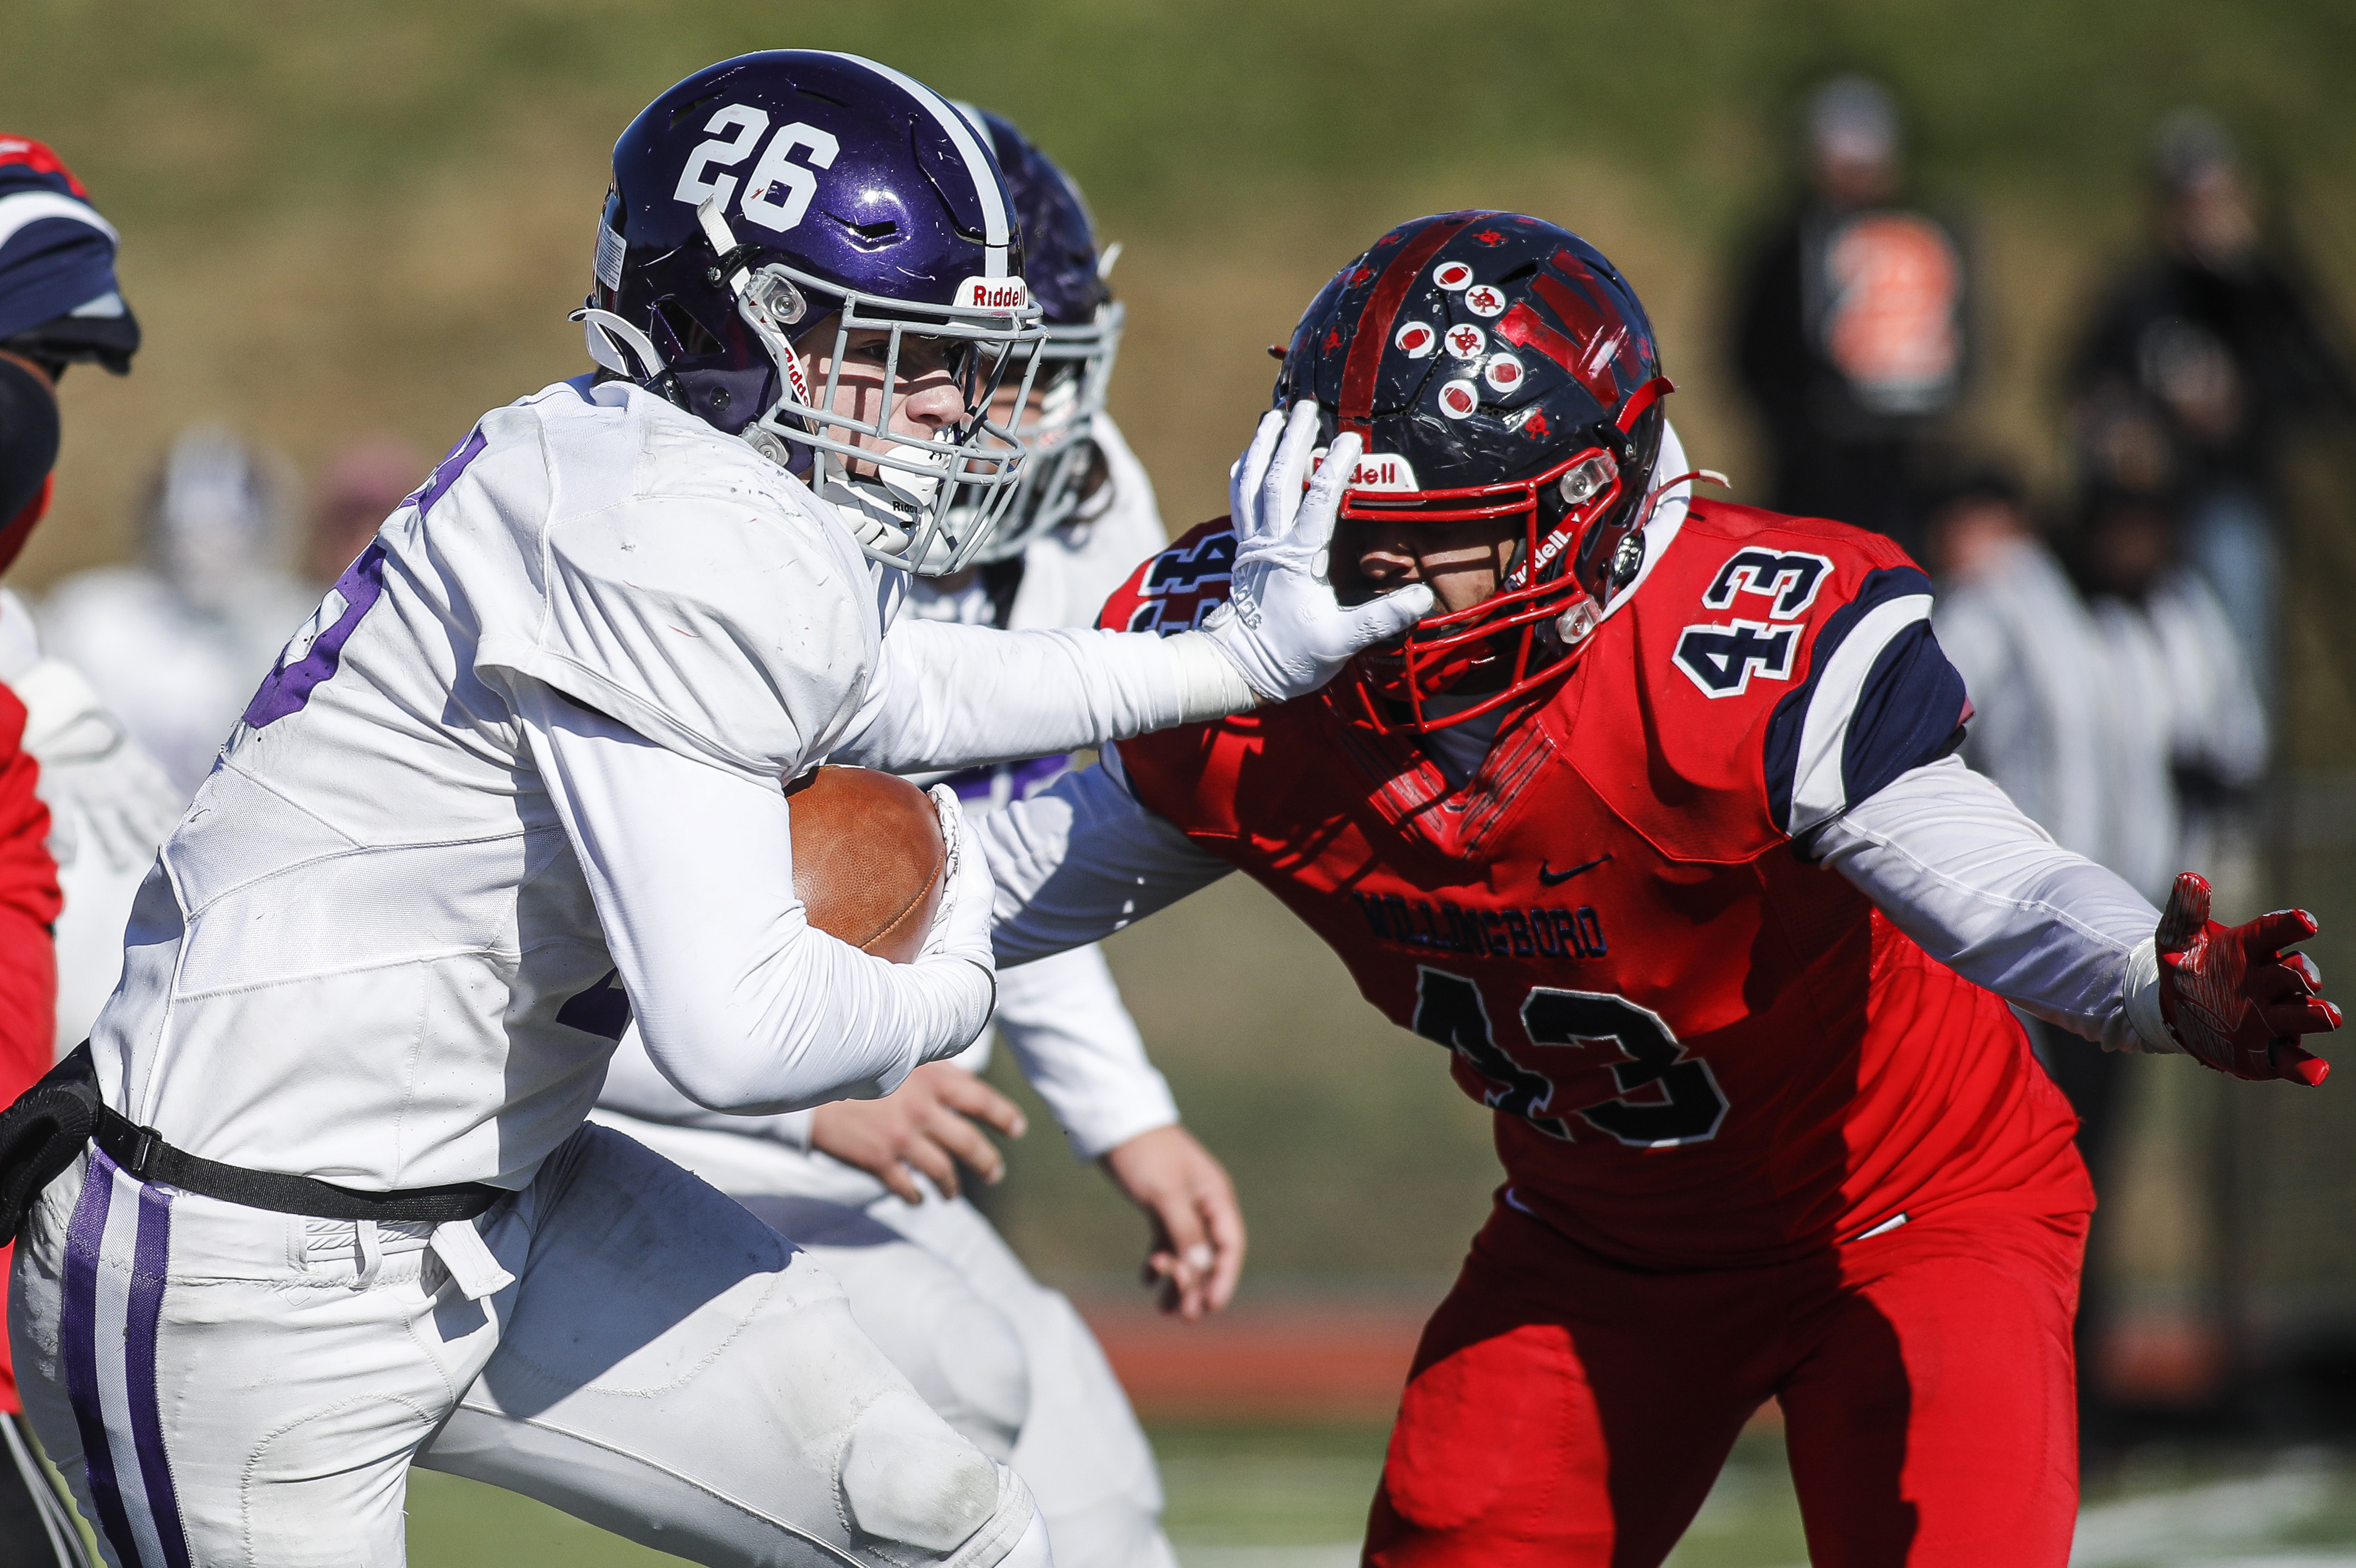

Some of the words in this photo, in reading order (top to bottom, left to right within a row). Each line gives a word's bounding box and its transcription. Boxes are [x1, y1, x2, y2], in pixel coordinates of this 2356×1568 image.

[674, 103, 840, 233] 26
[973, 285, 1026, 308] Riddell
[784, 347, 810, 409] Ridde
[1671, 545, 1835, 699] 43
[1353, 890, 1608, 958] WILLINGBORO
[1413, 963, 1730, 1148] 43
